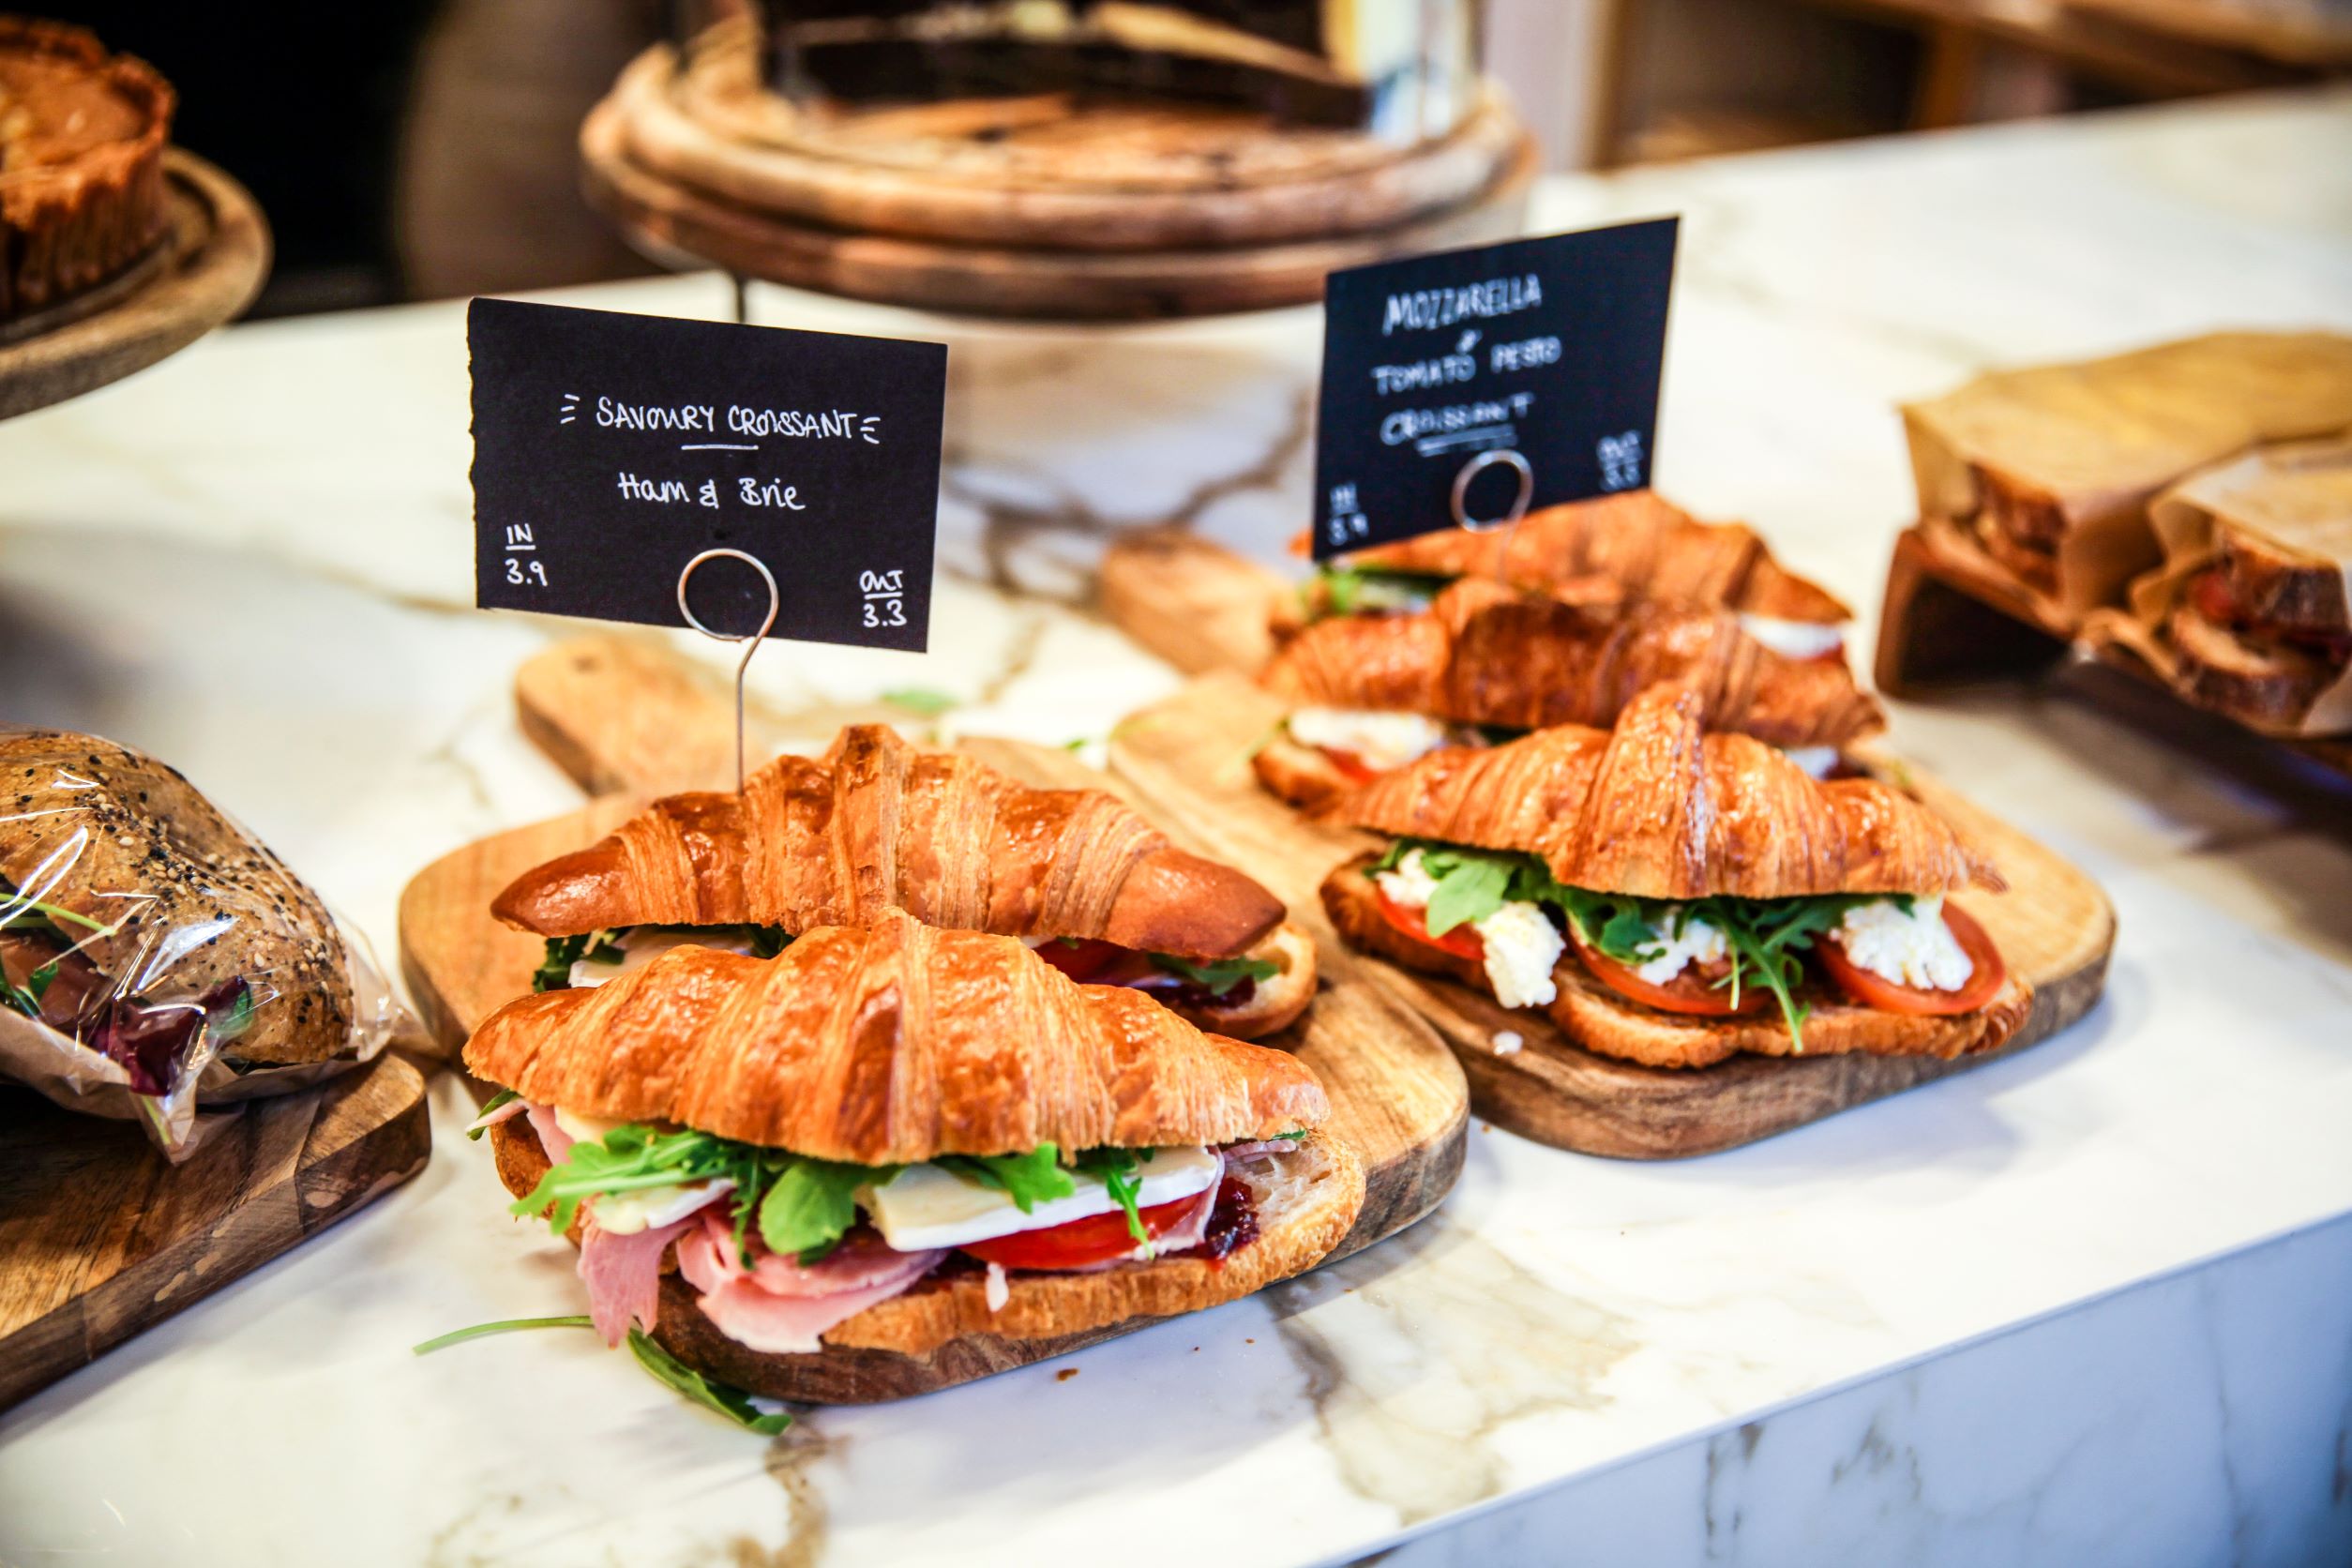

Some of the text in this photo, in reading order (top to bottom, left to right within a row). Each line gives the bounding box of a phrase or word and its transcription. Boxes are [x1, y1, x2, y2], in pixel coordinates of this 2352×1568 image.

[1381, 273, 1543, 336] MOZZARELLA
[1371, 335, 1562, 395] TOMATO PESTO
[596, 396, 857, 441] SAVOURY CROISSANT
[617, 472, 806, 510] Ham & Brie
[505, 522, 534, 544] IN
[505, 557, 549, 586] 3.9
[859, 569, 904, 593] OUT
[863, 600, 907, 627] 3.3
